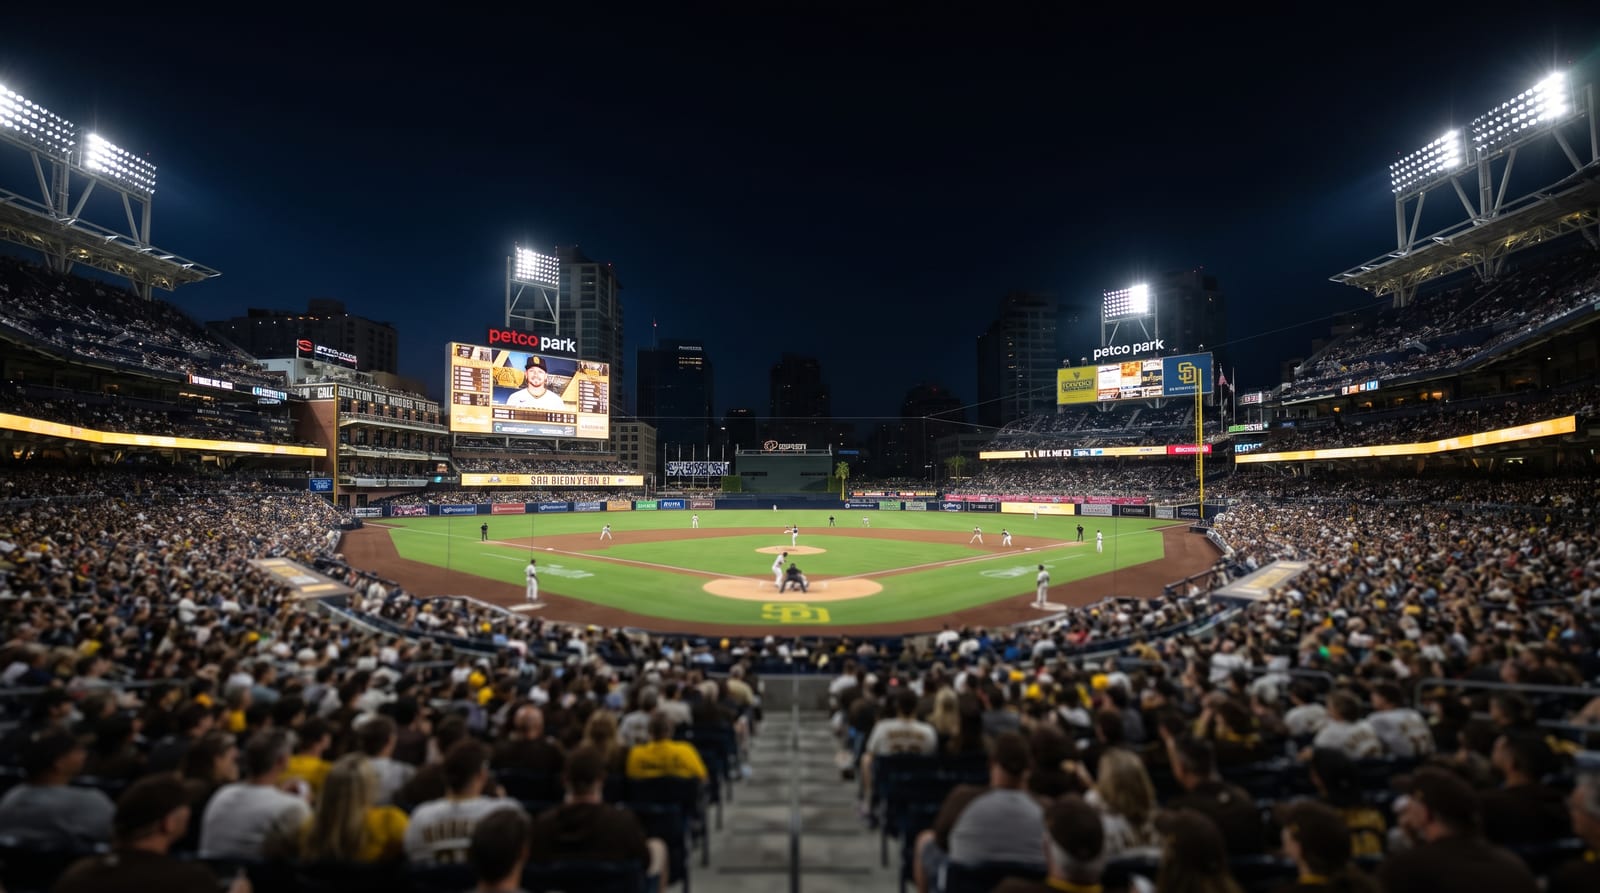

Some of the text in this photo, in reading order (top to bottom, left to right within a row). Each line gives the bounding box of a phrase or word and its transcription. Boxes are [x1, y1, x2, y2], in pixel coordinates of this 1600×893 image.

[489, 328, 576, 352] petco park
[1093, 338, 1165, 361] petco park
